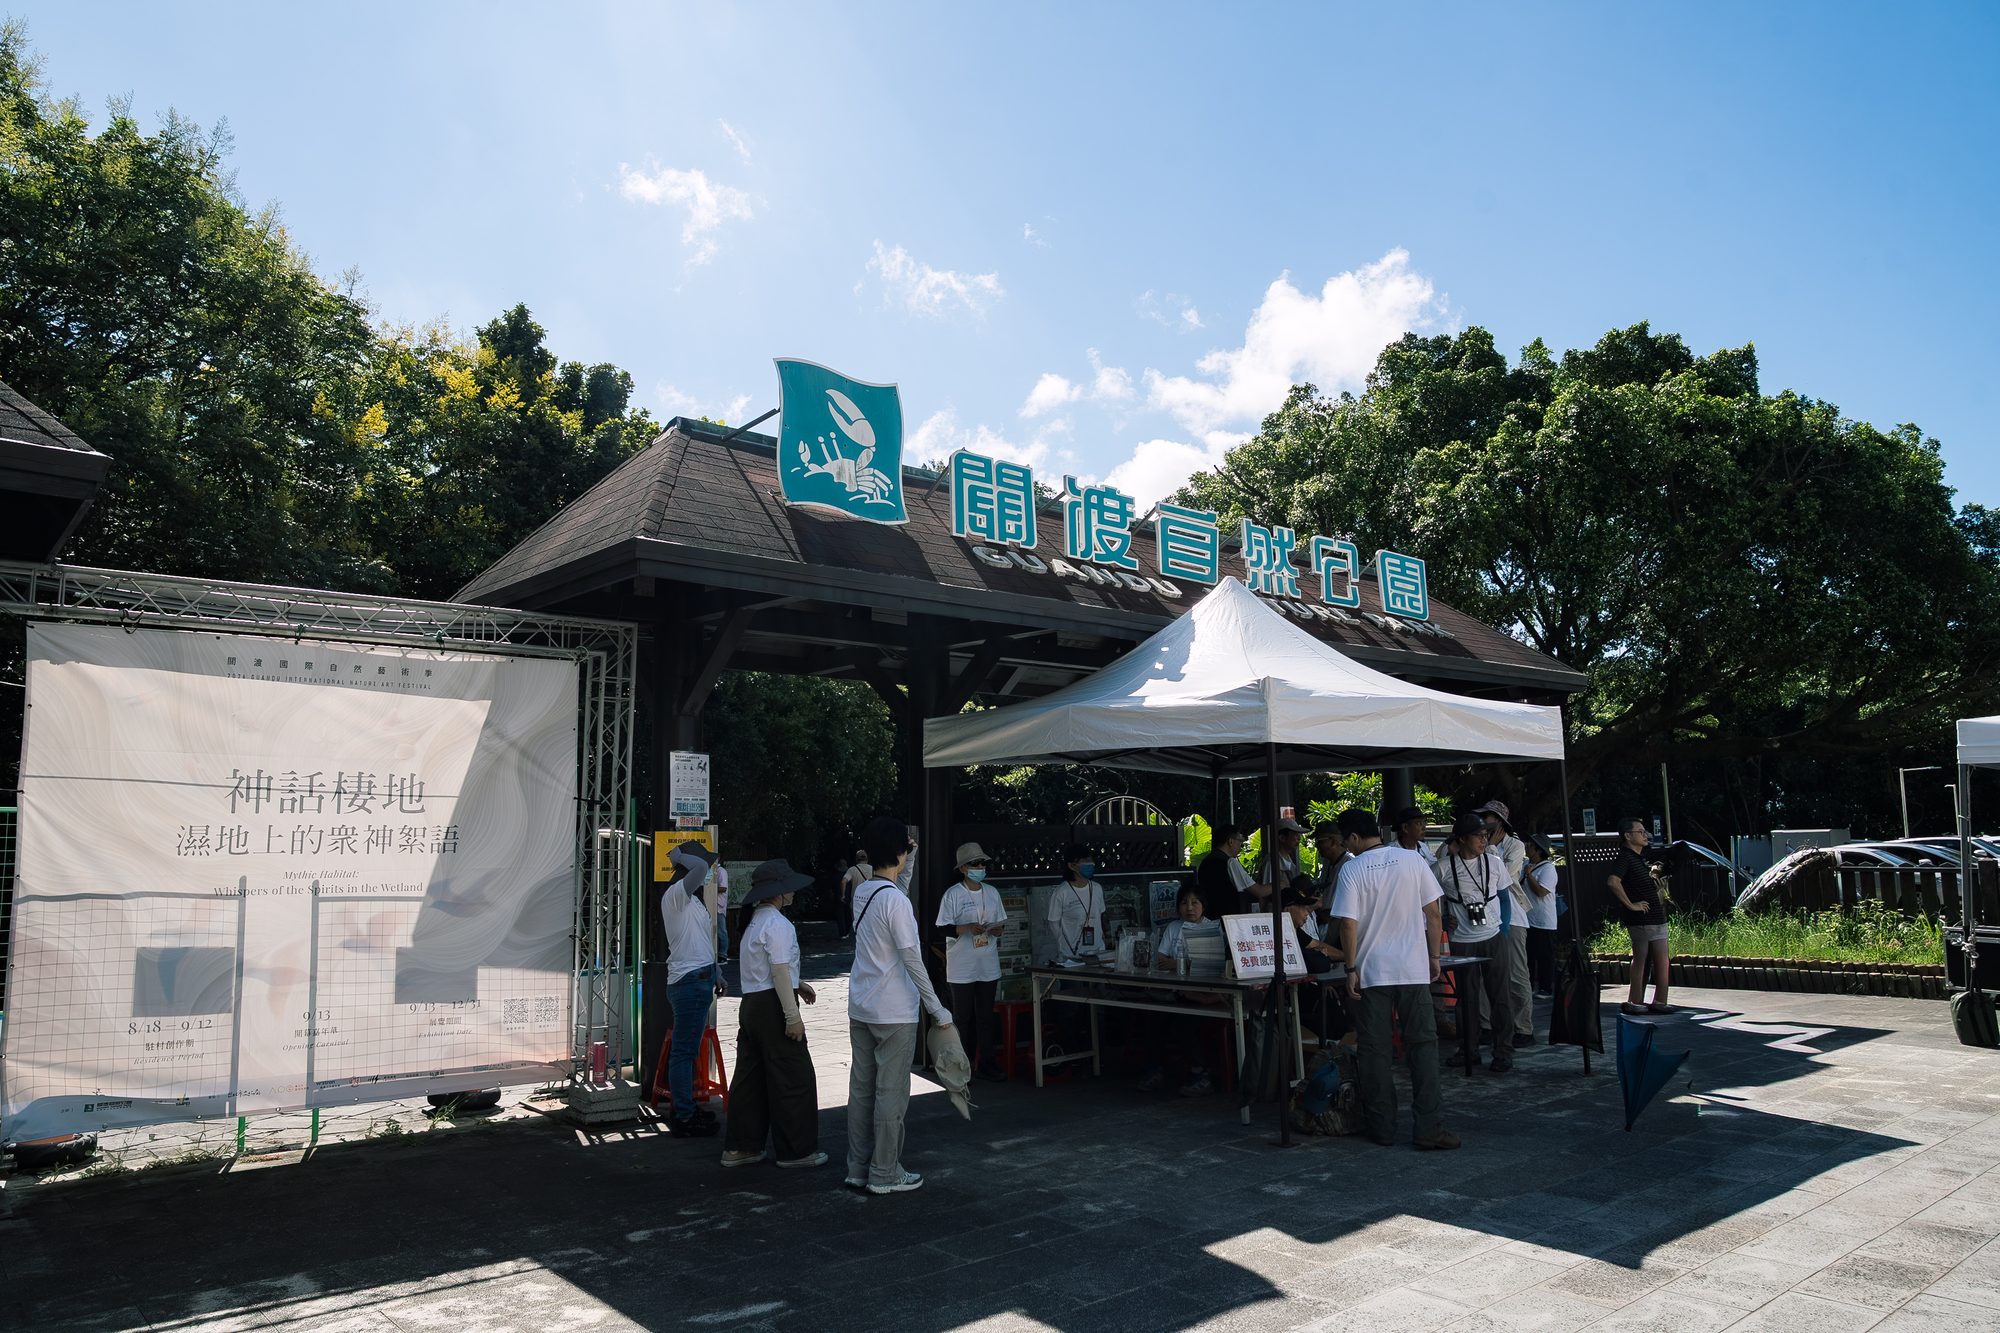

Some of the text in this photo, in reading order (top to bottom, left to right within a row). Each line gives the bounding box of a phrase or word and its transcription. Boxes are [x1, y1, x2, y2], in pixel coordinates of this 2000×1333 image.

[950, 447, 1428, 621] 關渡自然公園
[972, 546, 1183, 598] GUANDU
[1361, 612, 1455, 639] PARK
[285, 676, 345, 686] INTERNATIONAL
[398, 682, 431, 690] FESTIVAL
[224, 768, 426, 815] 神話棲地
[283, 869, 359, 880] Mythic Habitat:
[214, 882, 423, 898] Whispers of the Spirits in the Wetland
[1251, 925, 1270, 936] 請用
[1236, 939, 1293, 952] 悠遊卡或卡
[409, 999, 435, 1015] 9/13
[452, 998, 481, 1009] 12/31
[302, 1008, 331, 1021] 9/13
[128, 1019, 161, 1035] 8/18
[181, 1017, 213, 1032] 9/12
[282, 1039, 349, 1052] Opening Carnival
[133, 1052, 205, 1065] Residence Period
